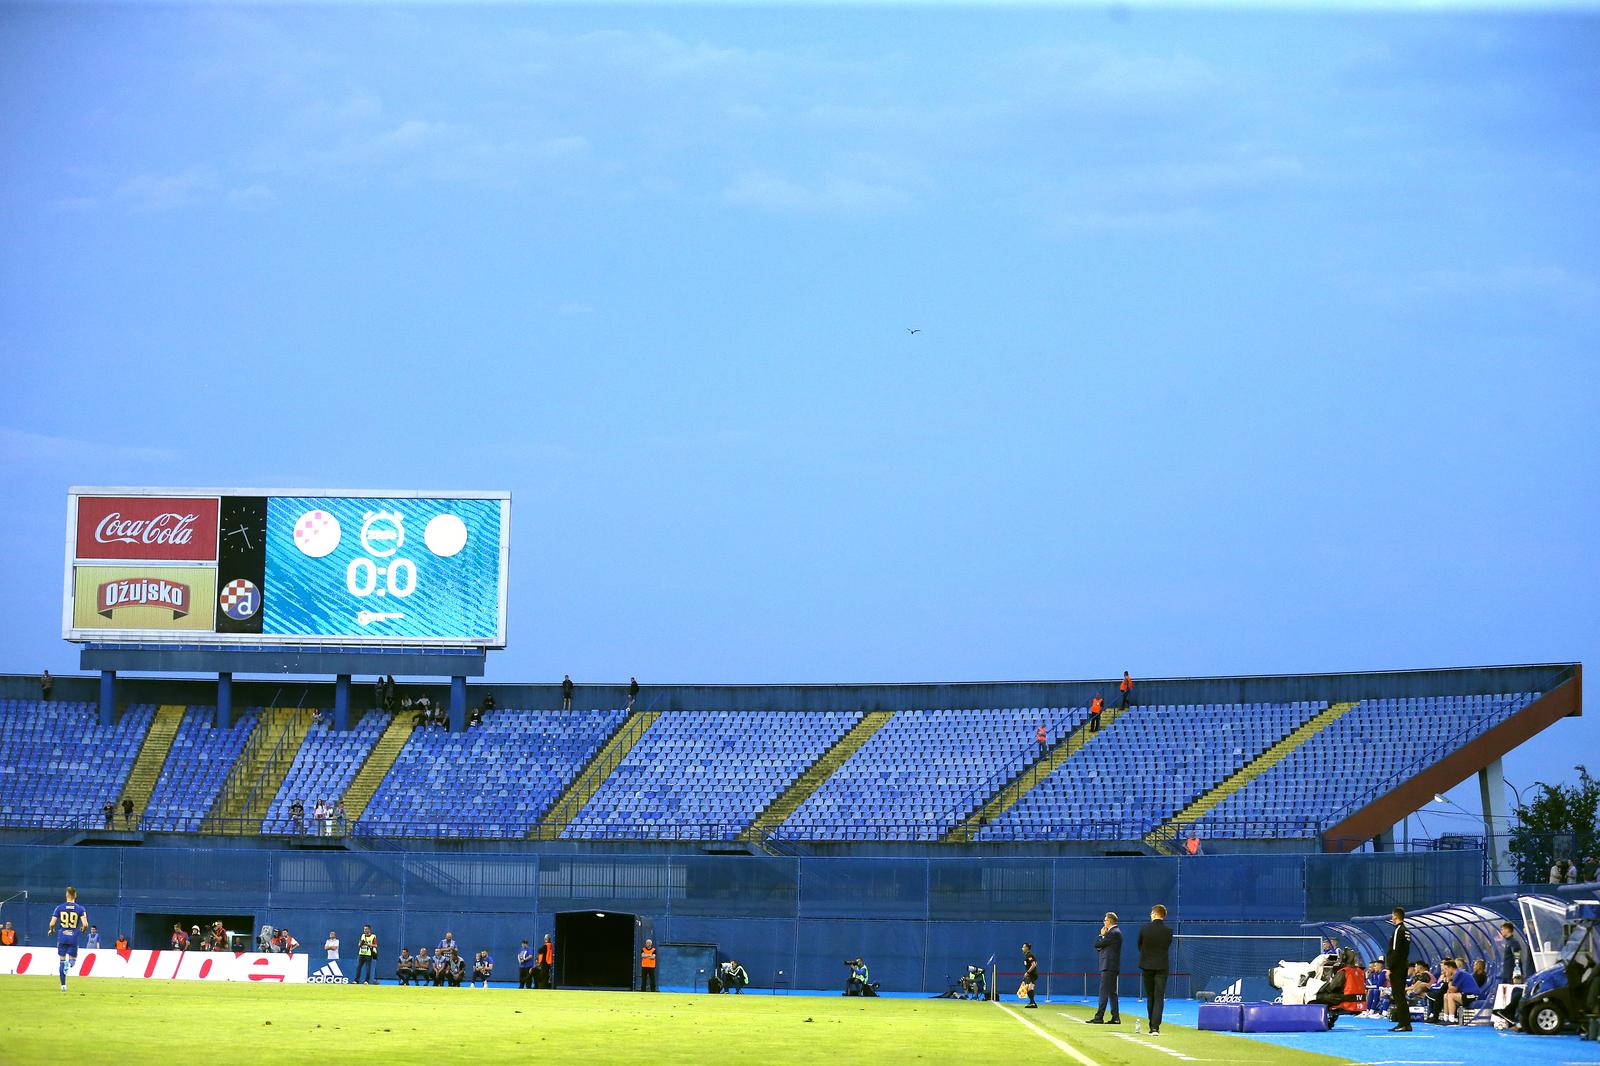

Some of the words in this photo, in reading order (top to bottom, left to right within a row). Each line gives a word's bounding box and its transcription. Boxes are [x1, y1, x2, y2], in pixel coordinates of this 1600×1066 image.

[95, 512, 200, 545] Coca-Cola
[347, 557, 417, 597] 0:0
[105, 579, 184, 607] Ožujsko
[60, 911, 79, 929] 99
[307, 974, 349, 984] adidas
[1214, 993, 1243, 1003] adidas
